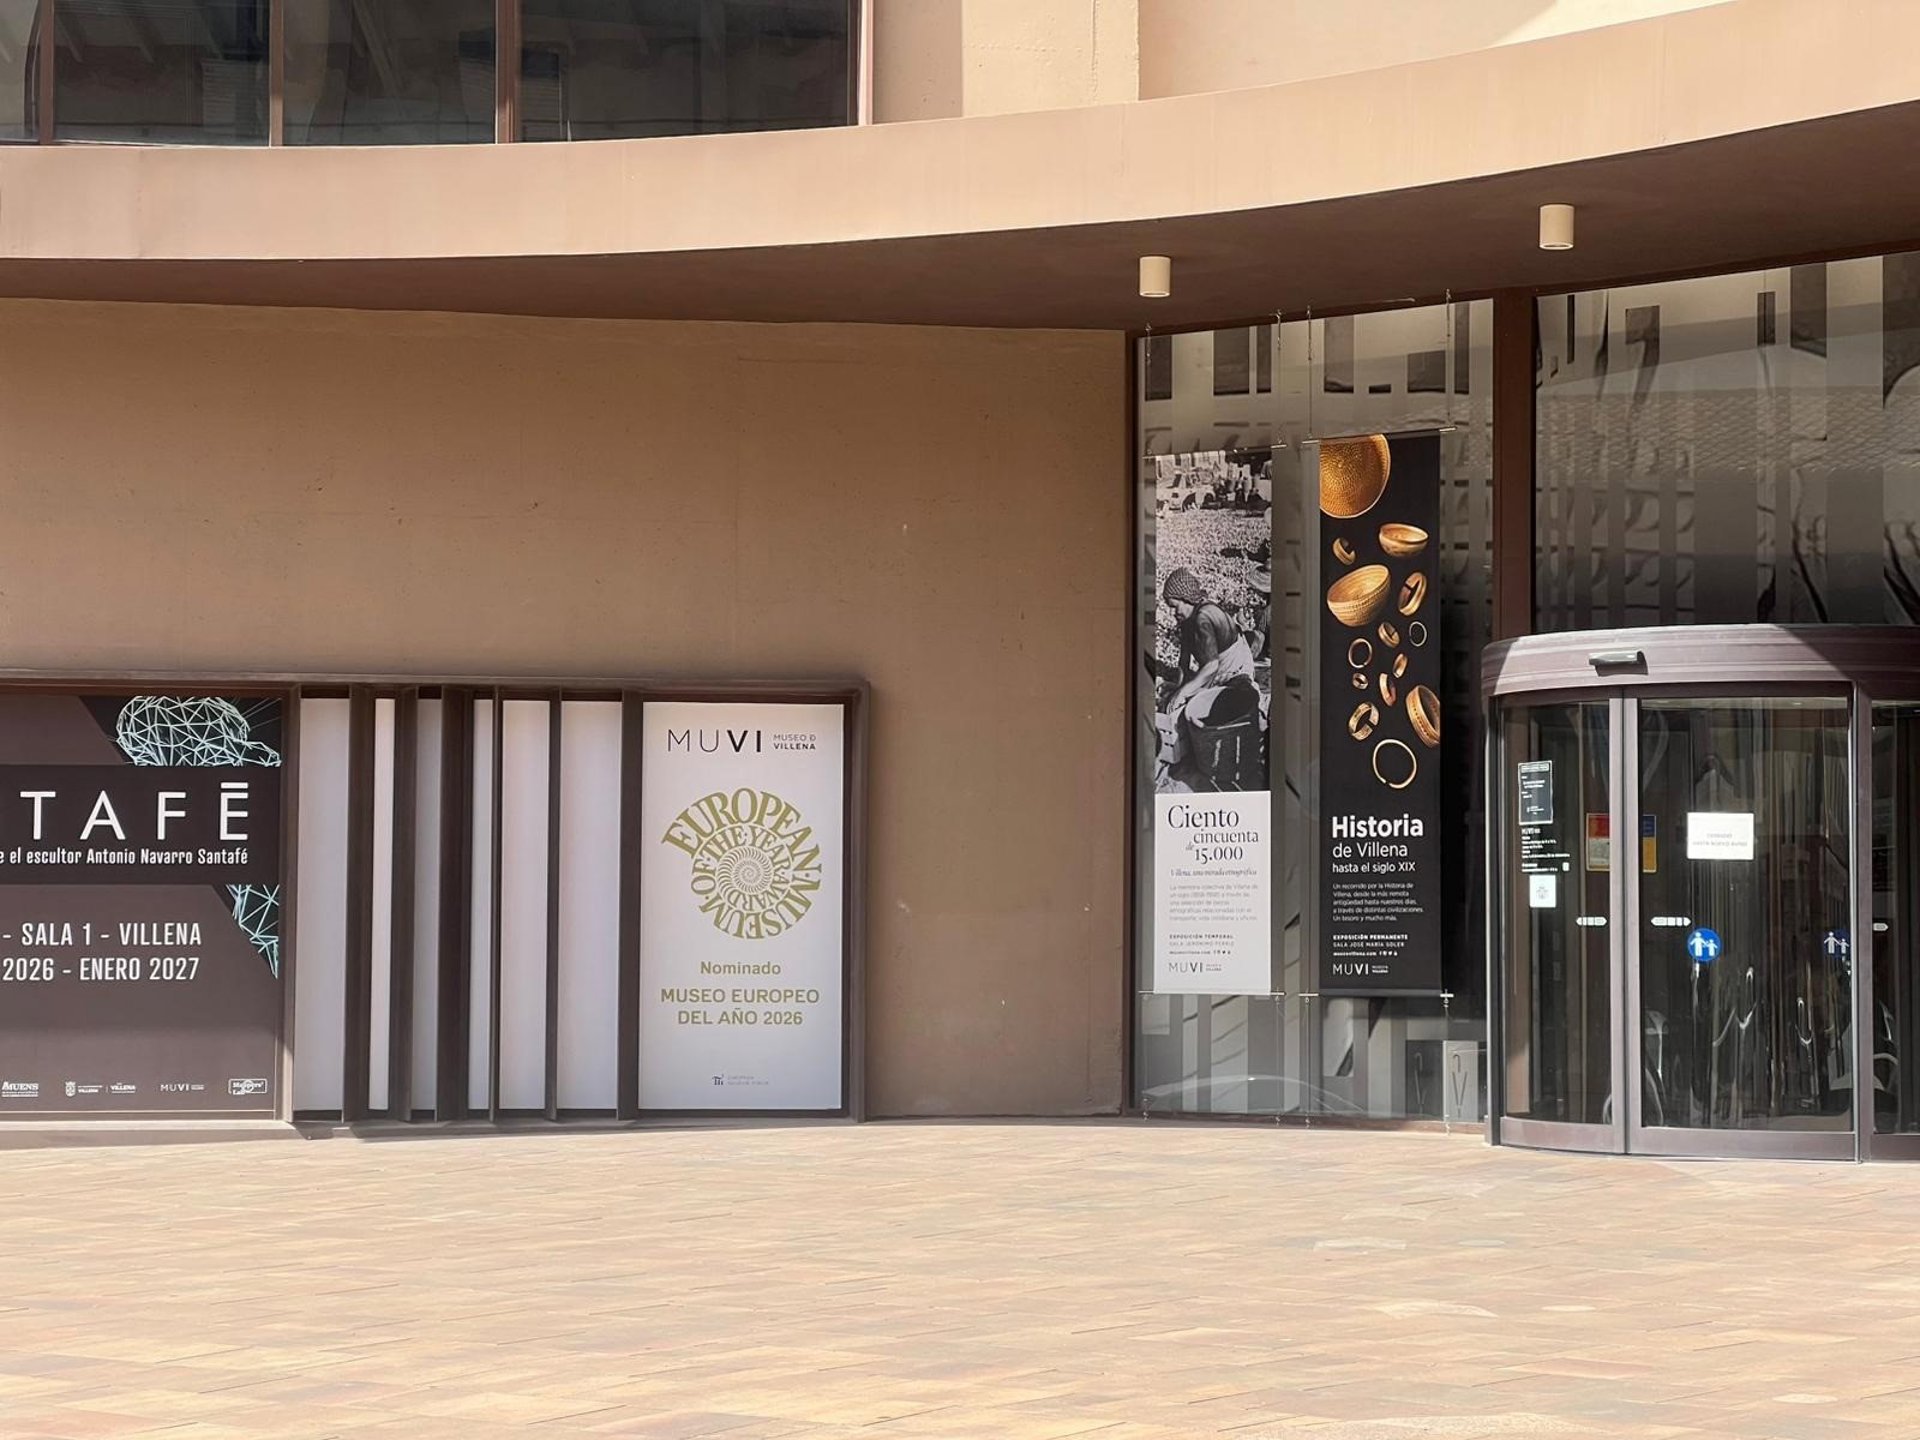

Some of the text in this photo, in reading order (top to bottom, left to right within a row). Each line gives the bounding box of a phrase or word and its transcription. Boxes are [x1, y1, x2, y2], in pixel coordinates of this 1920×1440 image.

[668, 729, 761, 753] MUVI
[773, 734, 807, 742] MUSEO
[1168, 804, 1239, 828] Ciento
[661, 787, 822, 873] EUROPEAN
[1332, 813, 1424, 838] Historia
[1193, 828, 1259, 844] cincuenta
[10, 847, 21, 864] el
[26, 848, 82, 864] escultor
[86, 848, 135, 864] Antonio
[140, 848, 192, 864] Navarro
[198, 847, 248, 864] Santafé
[1195, 846, 1243, 865] 15.000
[1333, 841, 1408, 858] de Villena
[691, 825, 792, 911] OF THE YEAR AWARD
[1332, 861, 1416, 874] hasta el siglo XIX
[699, 876, 821, 939] MUSEUM
[21, 922, 73, 946] SALA
[82, 922, 91, 946] 1
[119, 922, 202, 946] VILLENA
[2, 958, 54, 981] 2026
[80, 958, 140, 981] ENERO
[149, 957, 200, 981] 2027
[700, 961, 781, 975] Nominado
[1169, 962, 1203, 973] MUVI
[1333, 963, 1369, 975] MUVI
[661, 988, 820, 1004] MUSEO EUROPEO
[678, 1008, 803, 1025] DEL AÑO 2026
[160, 1083, 190, 1092] MUVI
